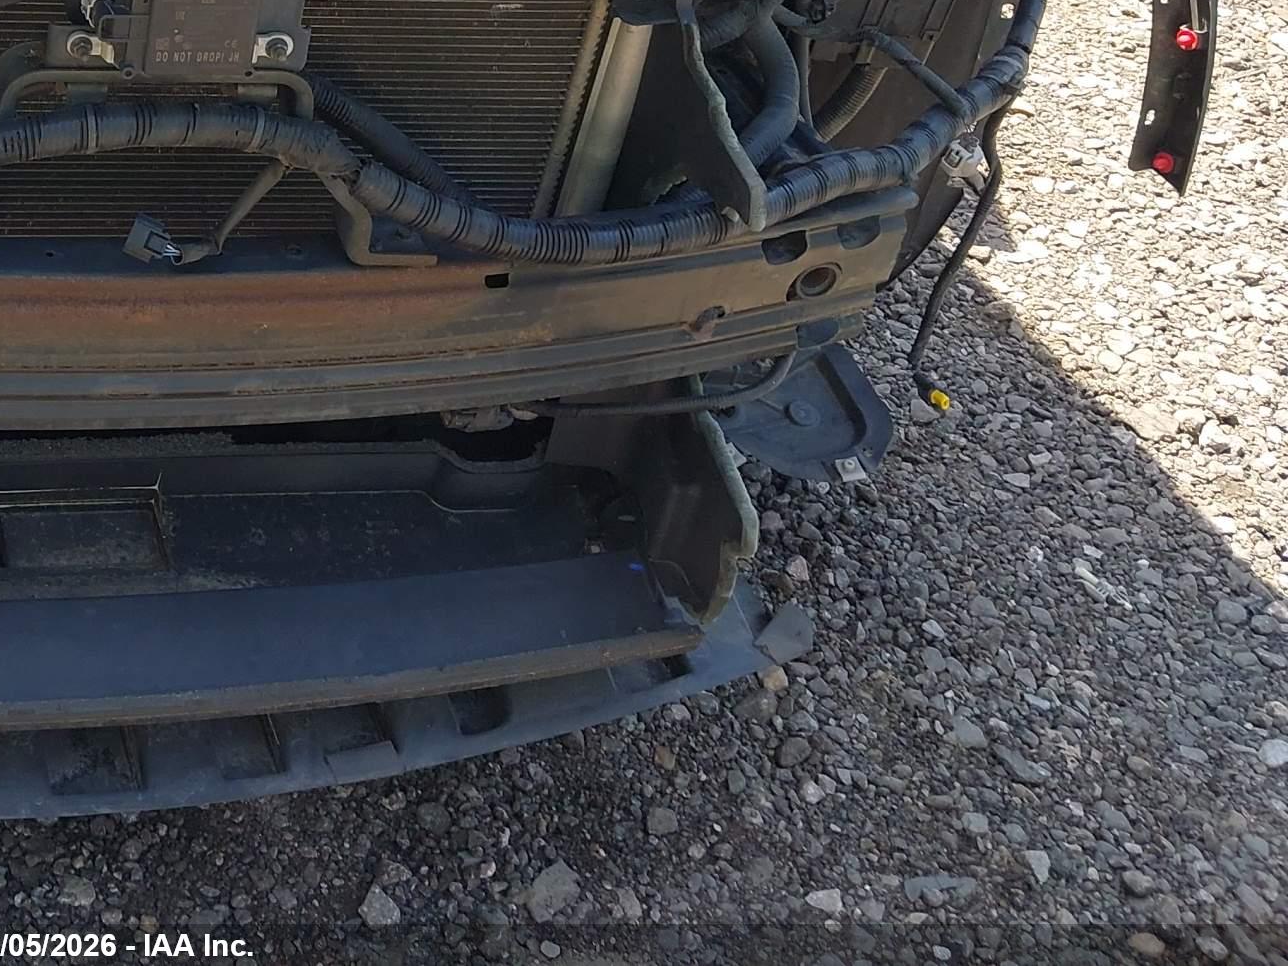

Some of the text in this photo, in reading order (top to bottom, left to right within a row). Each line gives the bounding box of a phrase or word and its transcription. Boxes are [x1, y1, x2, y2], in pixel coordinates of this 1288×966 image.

[155, 51, 169, 63] DO
[174, 51, 192, 63] NOT
[196, 51, 225, 63] DROP!
